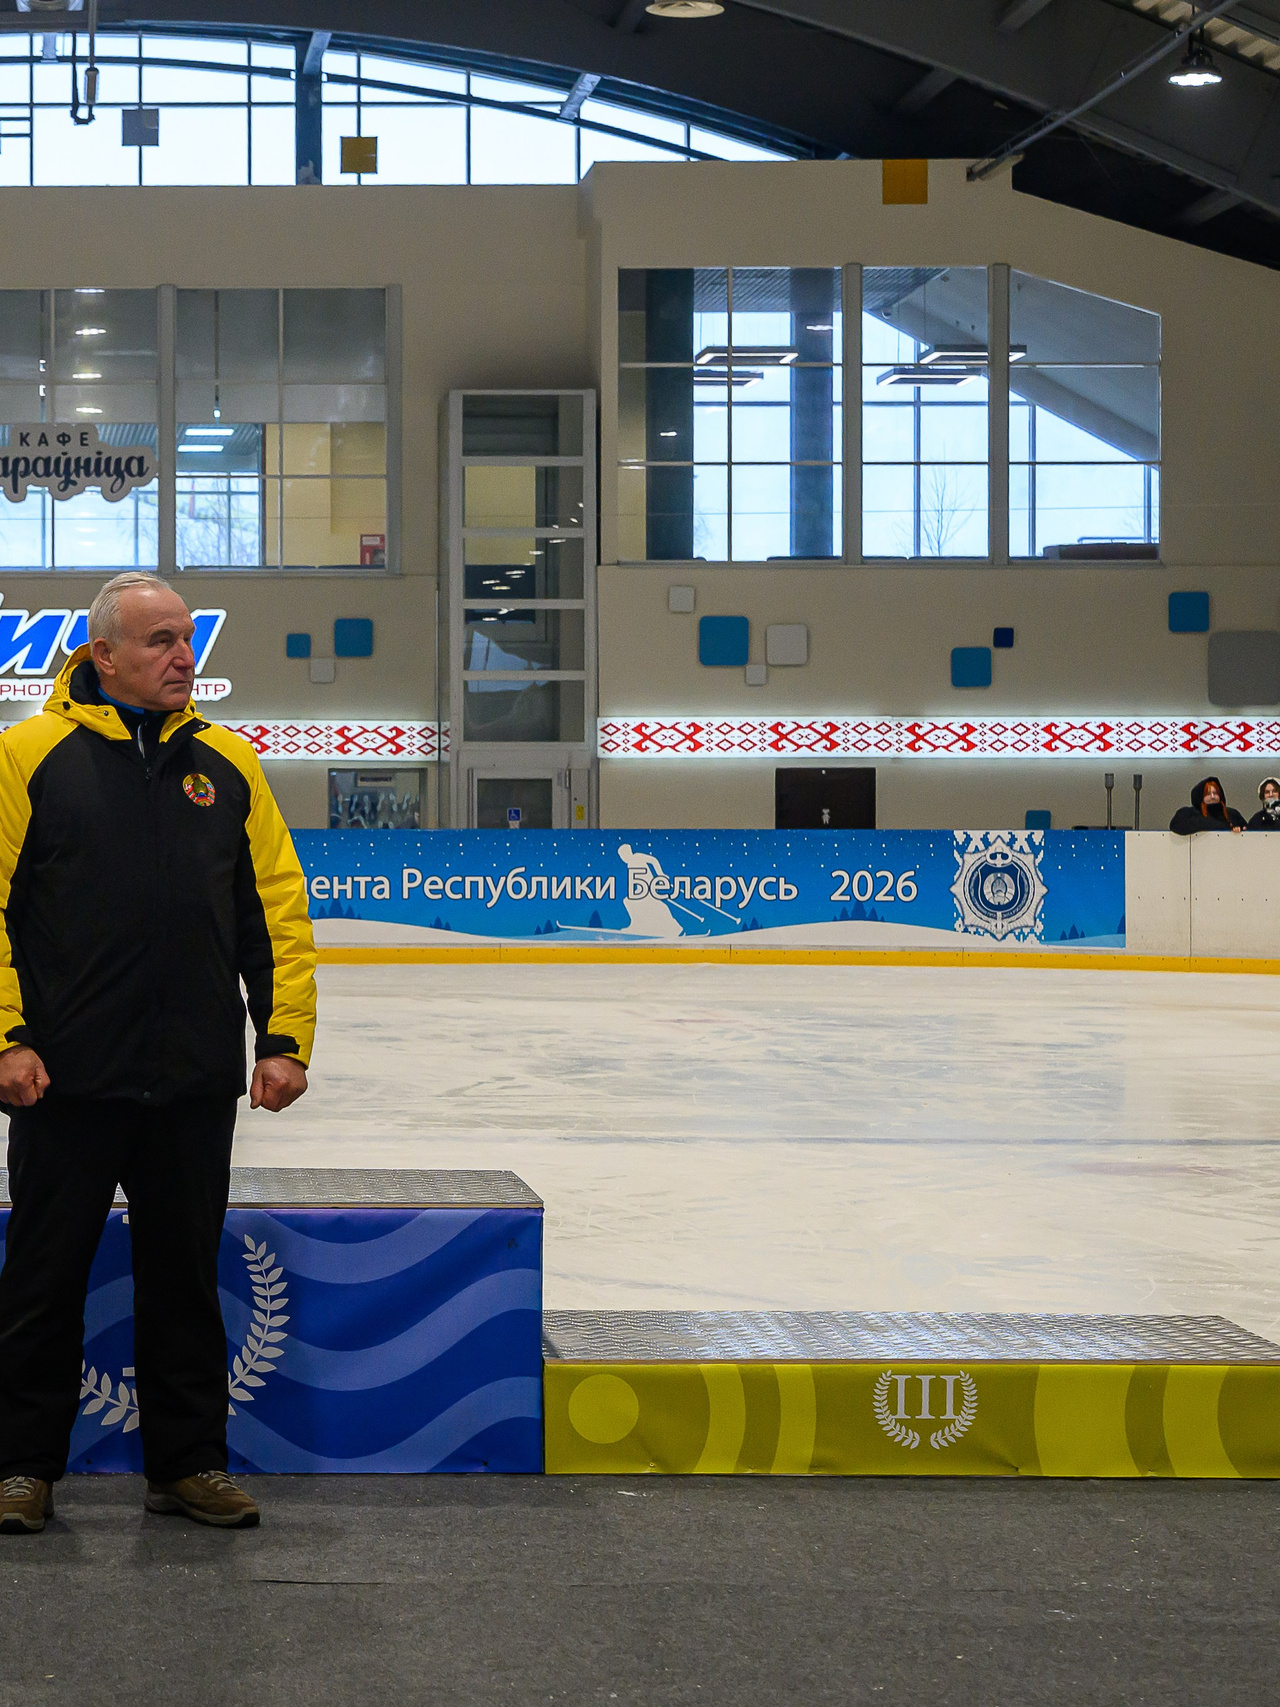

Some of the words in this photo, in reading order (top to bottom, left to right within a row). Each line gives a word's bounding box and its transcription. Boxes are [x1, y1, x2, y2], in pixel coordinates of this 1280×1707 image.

[19, 431, 90, 447] КАФЕ
[303, 875, 392, 905] ента
[402, 867, 616, 909] Республики
[628, 867, 799, 909] Беларусь
[829, 870, 919, 902] 2026
